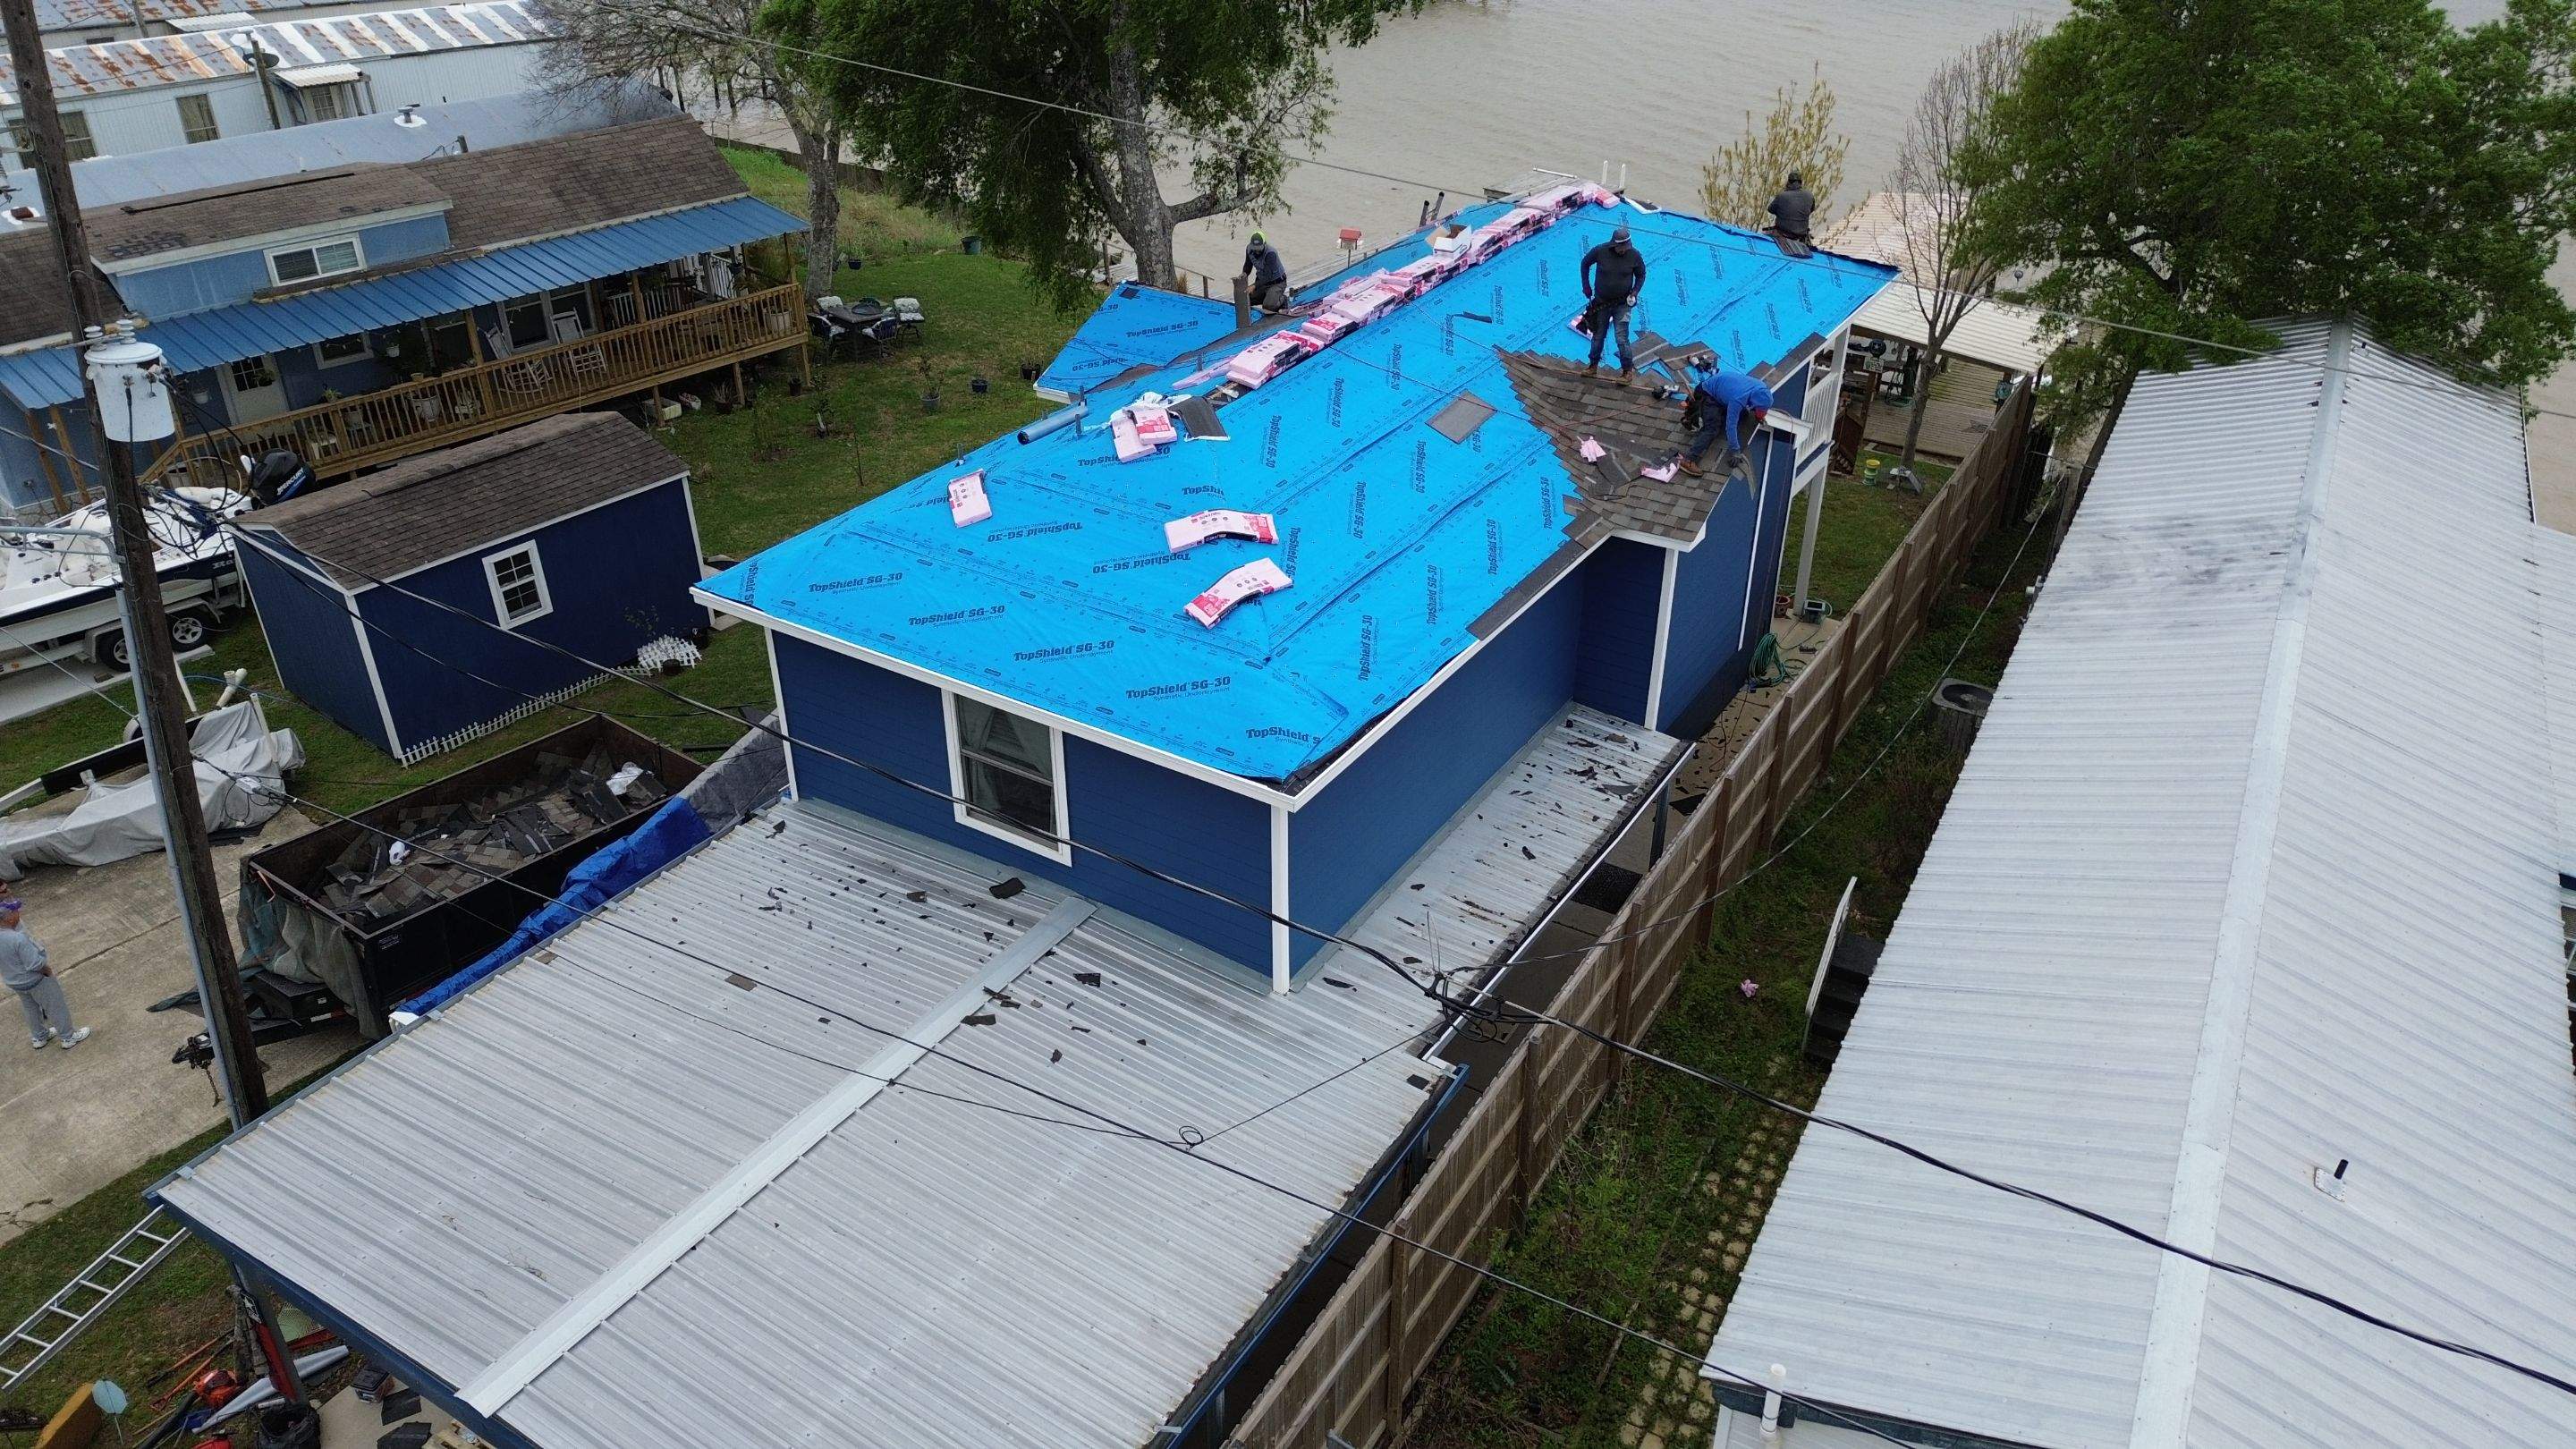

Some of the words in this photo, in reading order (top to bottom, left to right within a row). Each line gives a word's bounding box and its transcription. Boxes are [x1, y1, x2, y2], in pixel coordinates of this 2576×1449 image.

[1078, 454, 1120, 467] TopShi
[987, 530, 1024, 543] SG-30
[1028, 521, 1083, 538] TopShield
[1092, 561, 1130, 574] SG-30
[1133, 552, 1191, 570] TopShield
[809, 578, 864, 593] TopShield
[866, 572, 902, 583] SG-30
[908, 610, 964, 626] TopShield
[968, 605, 1005, 618] SG-30
[1361, 614, 1373, 641] SG-30
[1013, 646, 1072, 662] TopShield
[1075, 640, 1114, 653] SG-30
[1359, 640, 1371, 681] TopShield
[1125, 682, 1188, 699] TopShield
[1191, 676, 1231, 689] SG-30
[1245, 725, 1310, 742] TopShield
